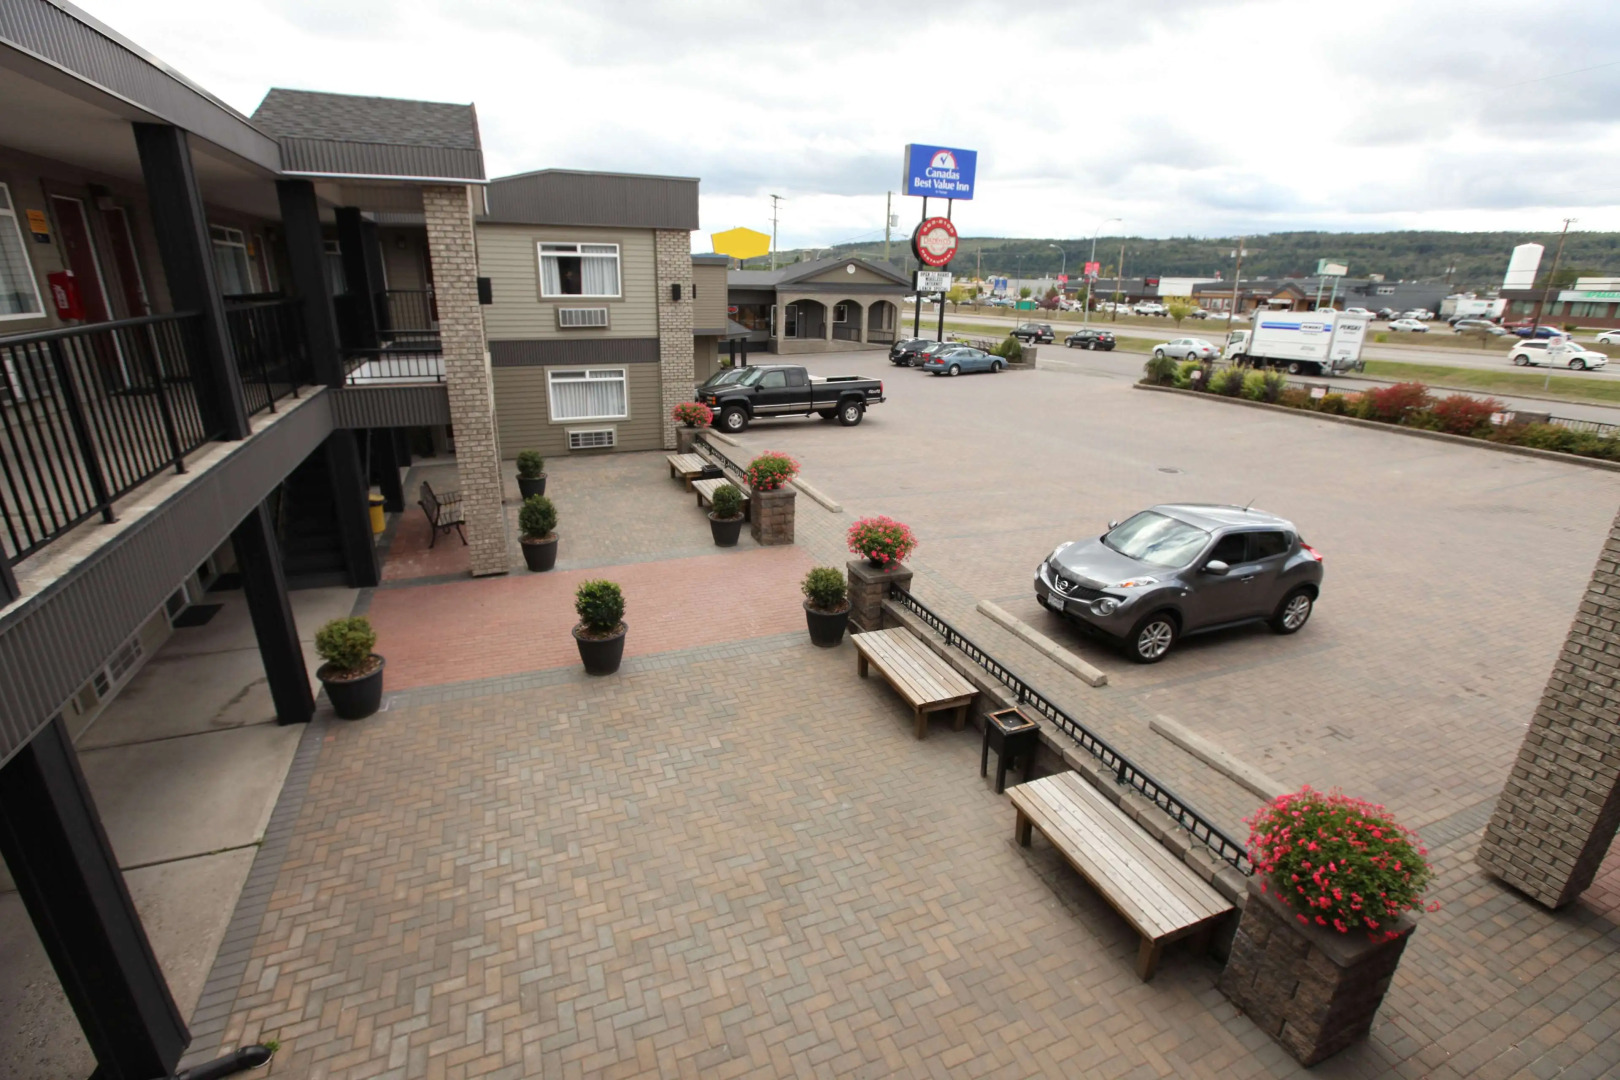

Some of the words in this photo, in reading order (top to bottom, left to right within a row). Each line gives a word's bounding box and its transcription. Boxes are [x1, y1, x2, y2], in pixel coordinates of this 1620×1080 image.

[925, 167, 960, 180] Canadas
[914, 177, 932, 188] Best
[933, 179, 955, 190] Value
[956, 181, 970, 192] Inn
[921, 249, 953, 264] RESTAURANT
